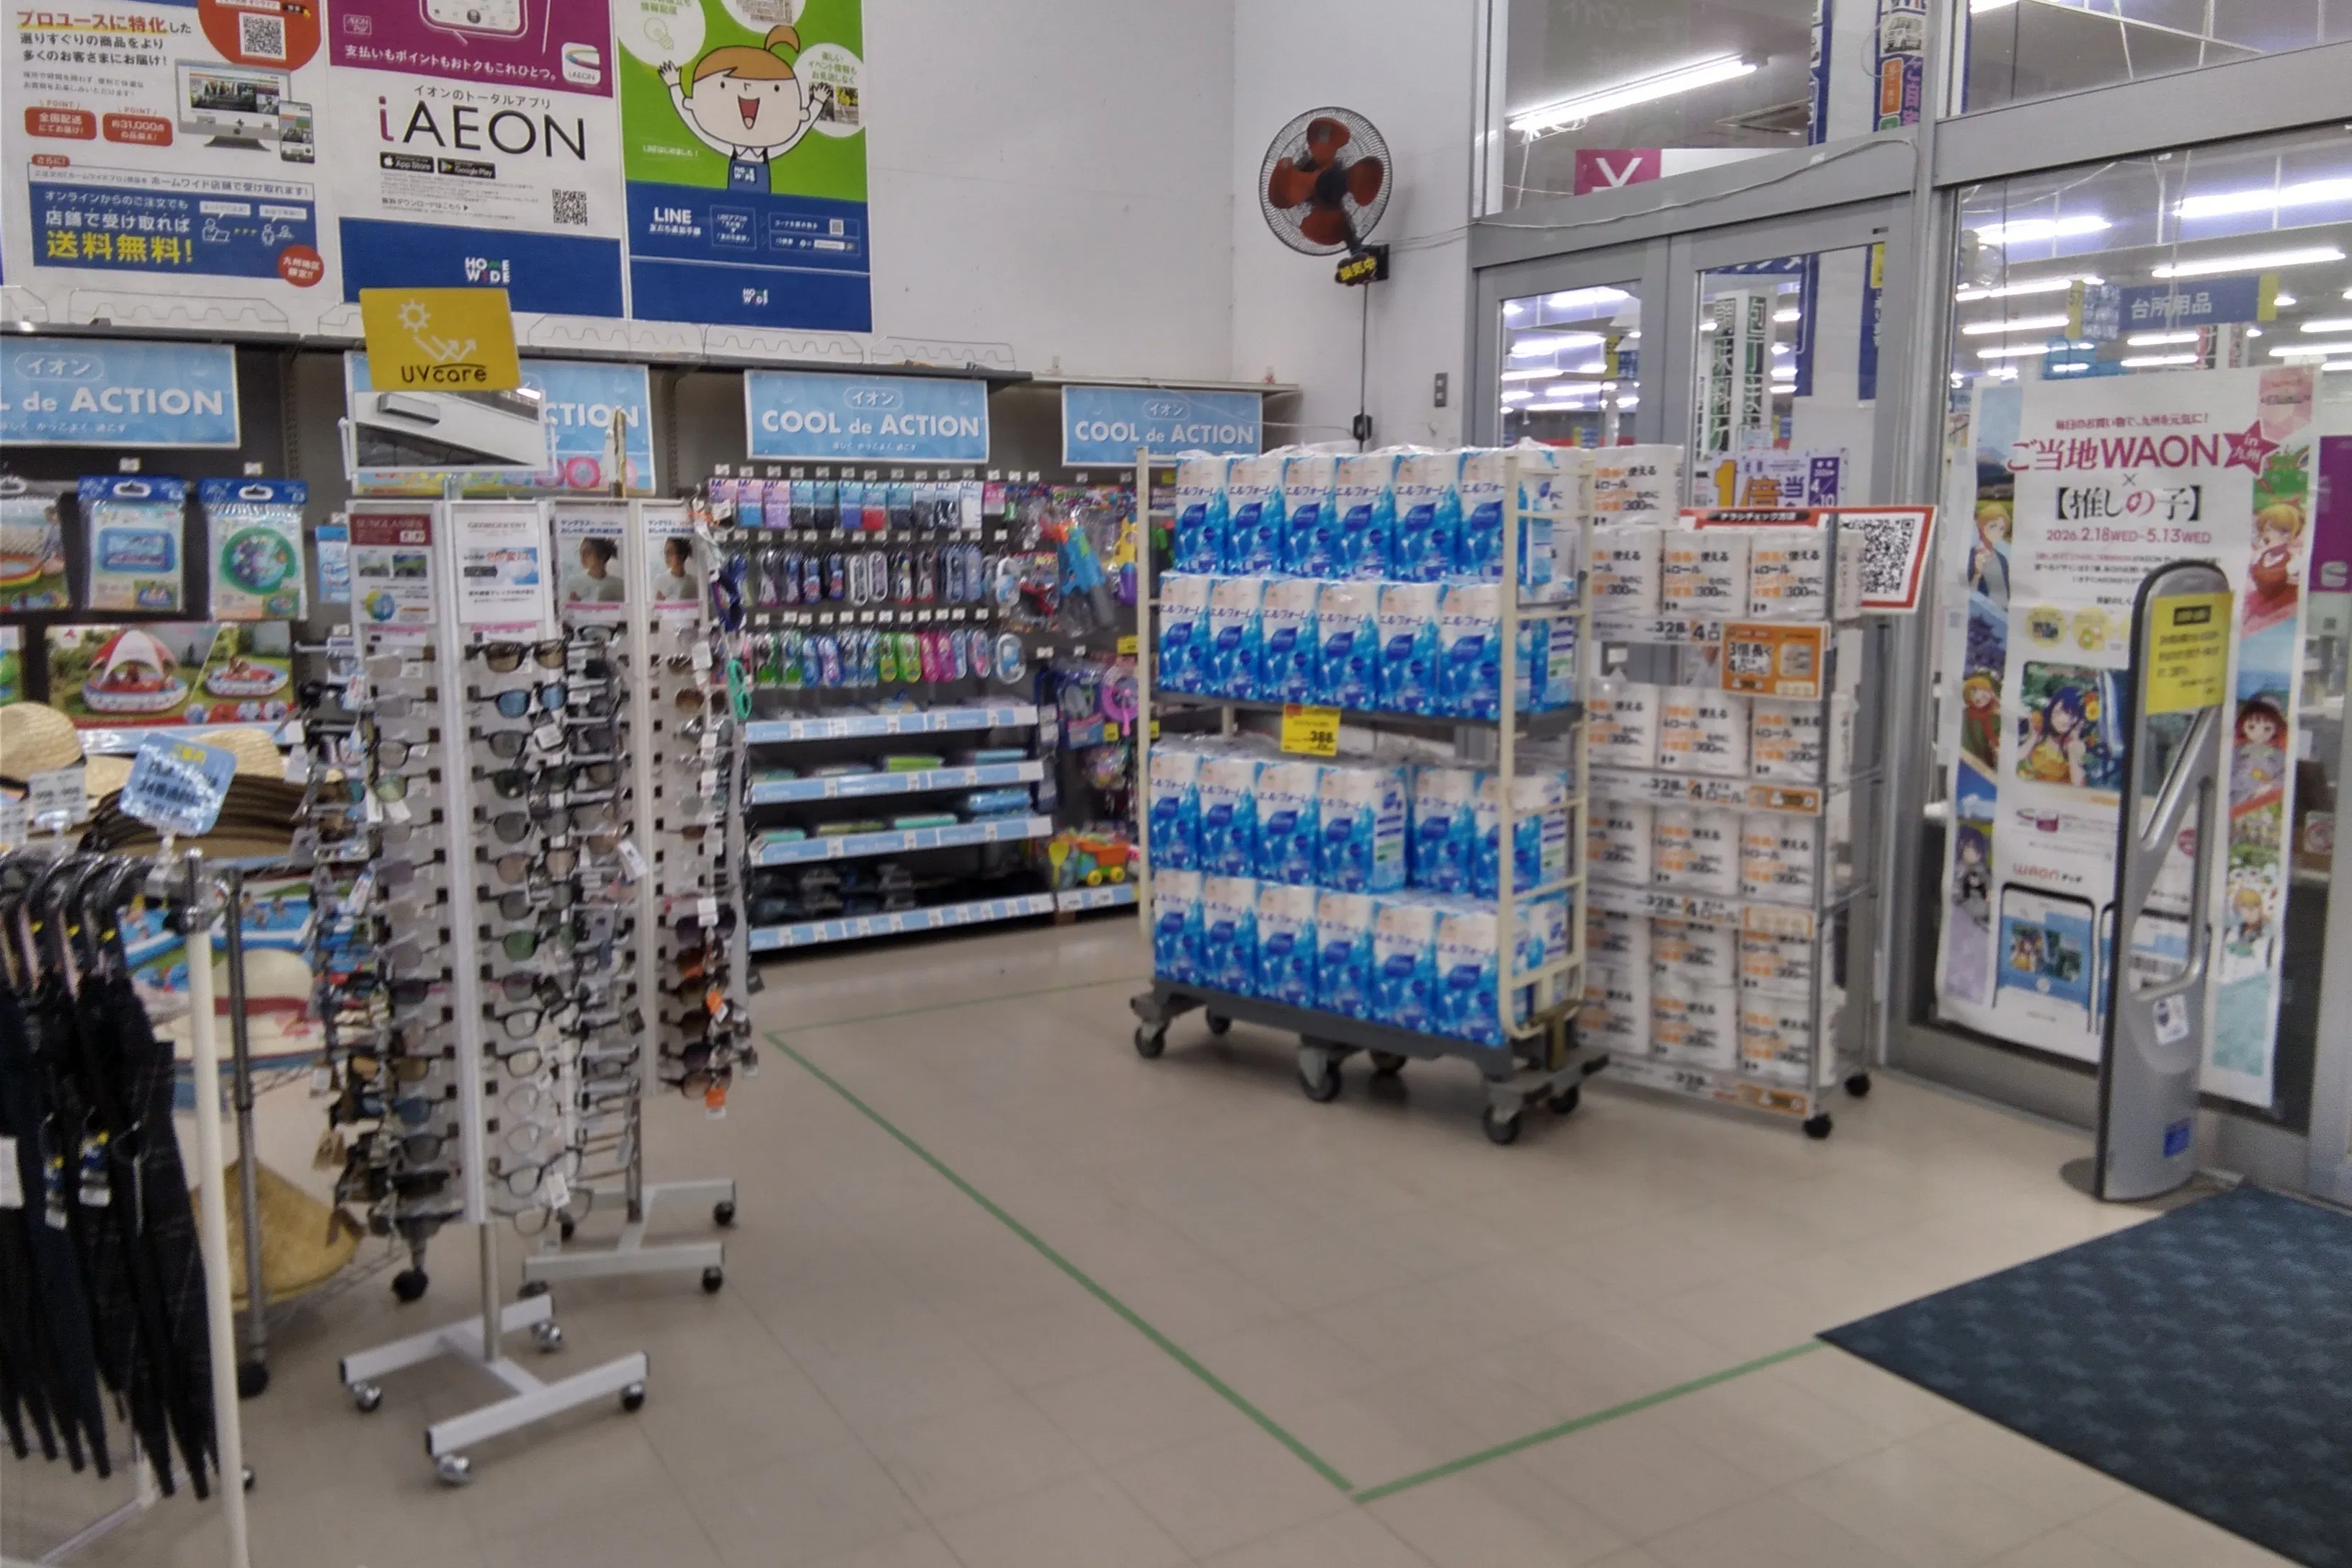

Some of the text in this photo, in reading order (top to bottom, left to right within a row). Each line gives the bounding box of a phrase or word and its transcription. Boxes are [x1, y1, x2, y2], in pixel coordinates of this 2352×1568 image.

[17, 10, 192, 34] プロユースに特化した
[20, 32, 164, 49] 選りすぐりの商品をより
[414, 84, 551, 110] イオンのトータルアプリ
[378, 95, 587, 161] iAEON
[396, 160, 432, 172] App Store
[455, 166, 494, 178] Google Play
[45, 191, 189, 210] オンラインからのご注文でも
[45, 209, 191, 233] 店舗で受け取れば
[654, 207, 692, 225] LINE
[2131, 291, 2213, 320] 台所用品
[27, 357, 91, 376] イオン
[22, 386, 223, 416] de ACTION
[852, 390, 895, 407] イオン
[1149, 402, 1184, 417] イオン
[544, 403, 639, 428] CTION
[762, 409, 979, 437] COOL de ACTION
[1075, 421, 1254, 445] COOL de ACTION
[2008, 434, 2220, 472] ご当地WAON
[1461, 481, 1505, 494] エルフォー
[2057, 484, 2202, 522] 【推しの子】
